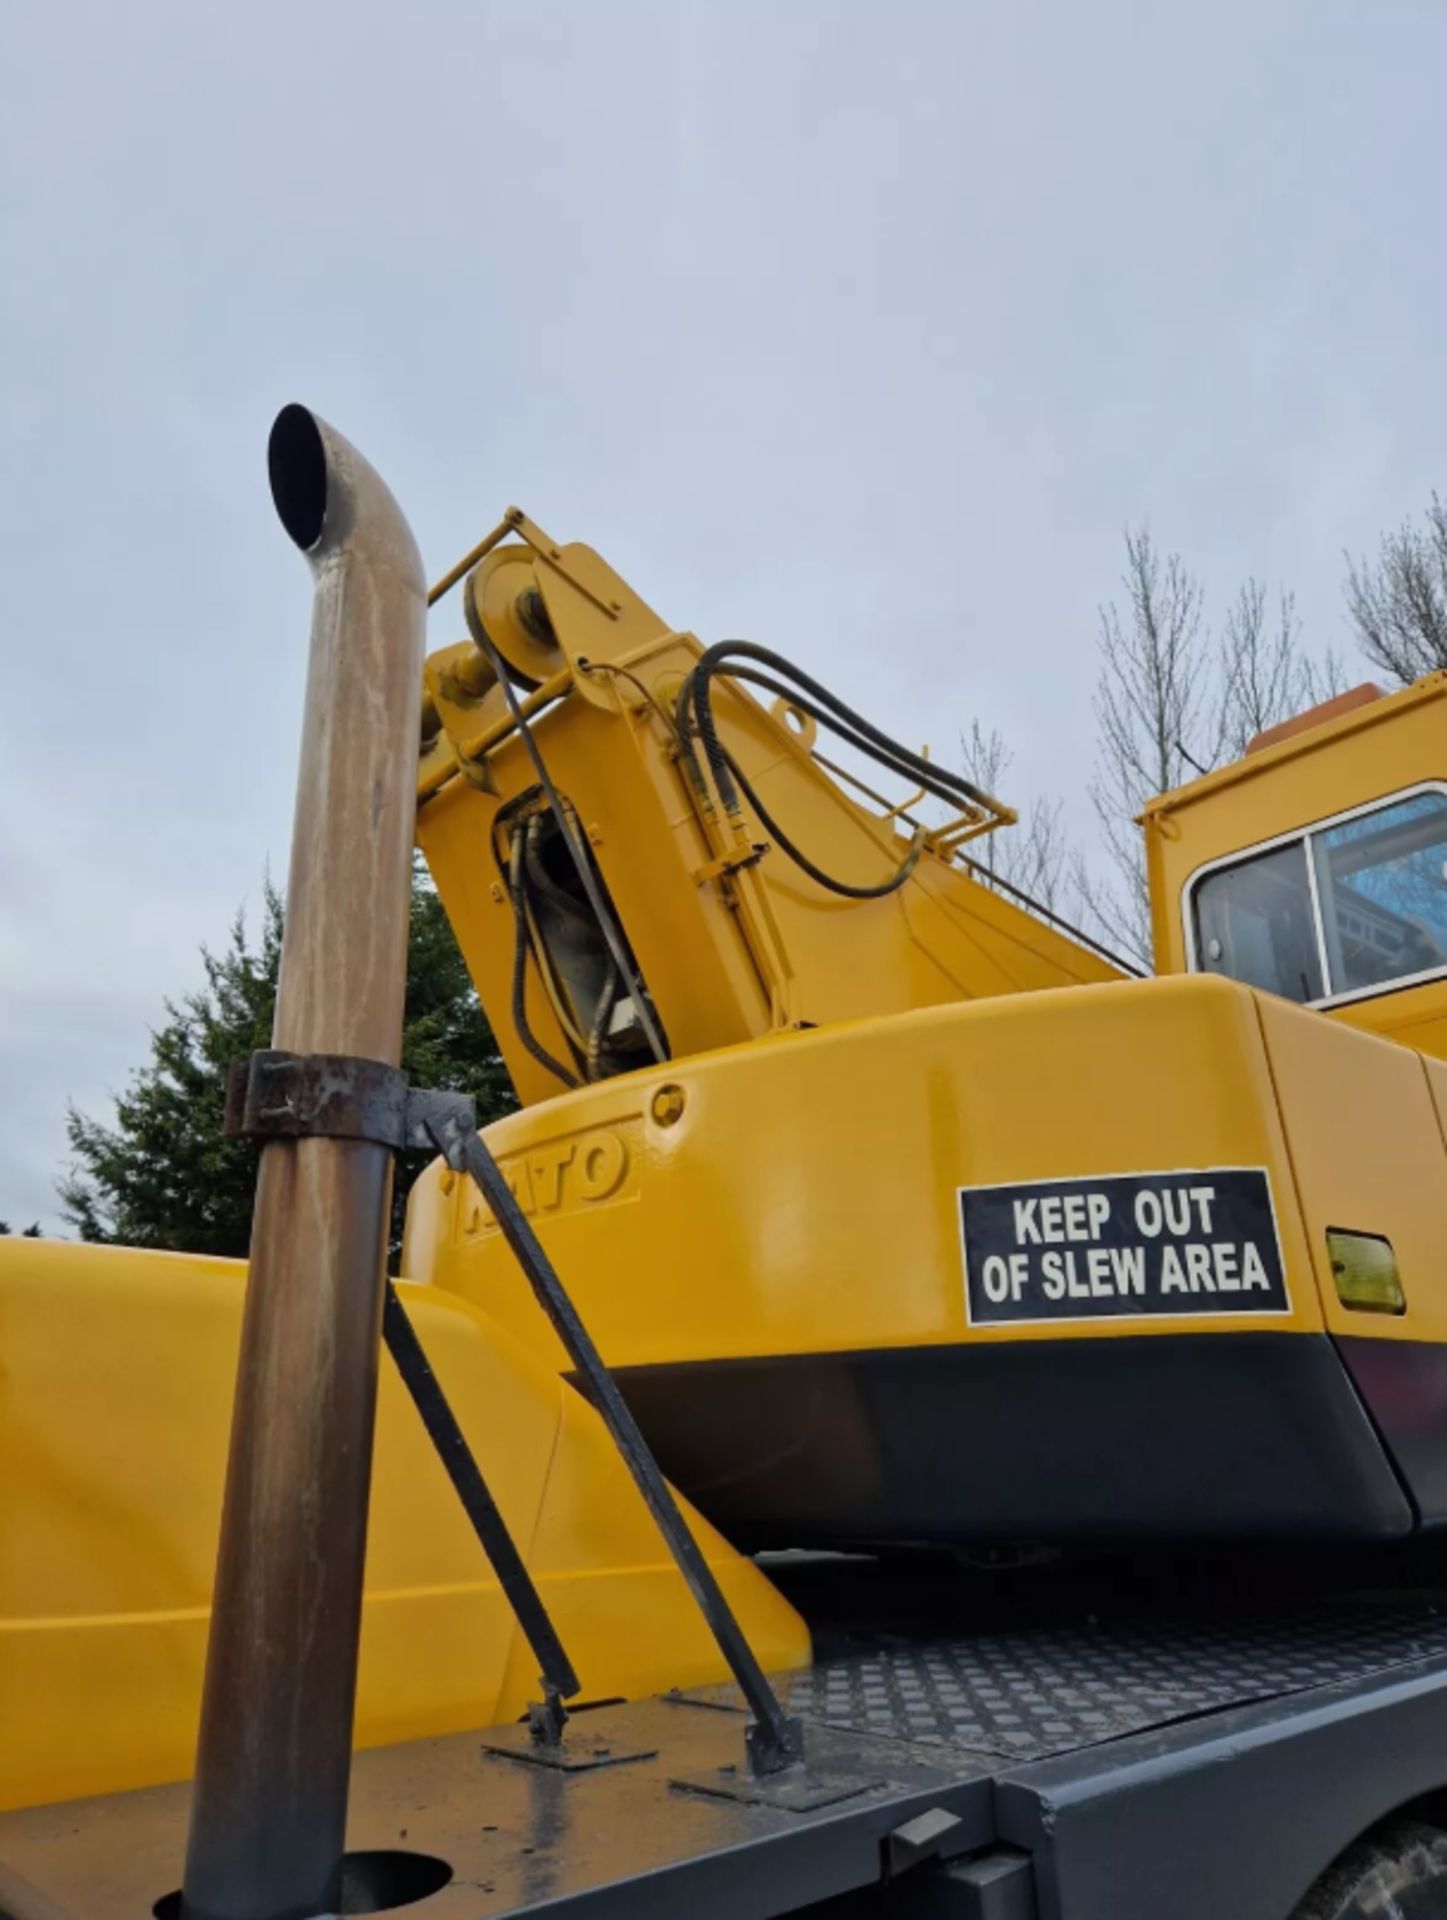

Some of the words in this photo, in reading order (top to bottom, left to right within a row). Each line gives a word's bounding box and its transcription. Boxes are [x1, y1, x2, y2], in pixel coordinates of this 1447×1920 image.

[1013, 1194, 1110, 1244] KEEP
[1135, 1187, 1215, 1237] OUT
[982, 1254, 1028, 1302] OF
[1042, 1247, 1145, 1299] SLEW
[1160, 1242, 1271, 1293] AREA
